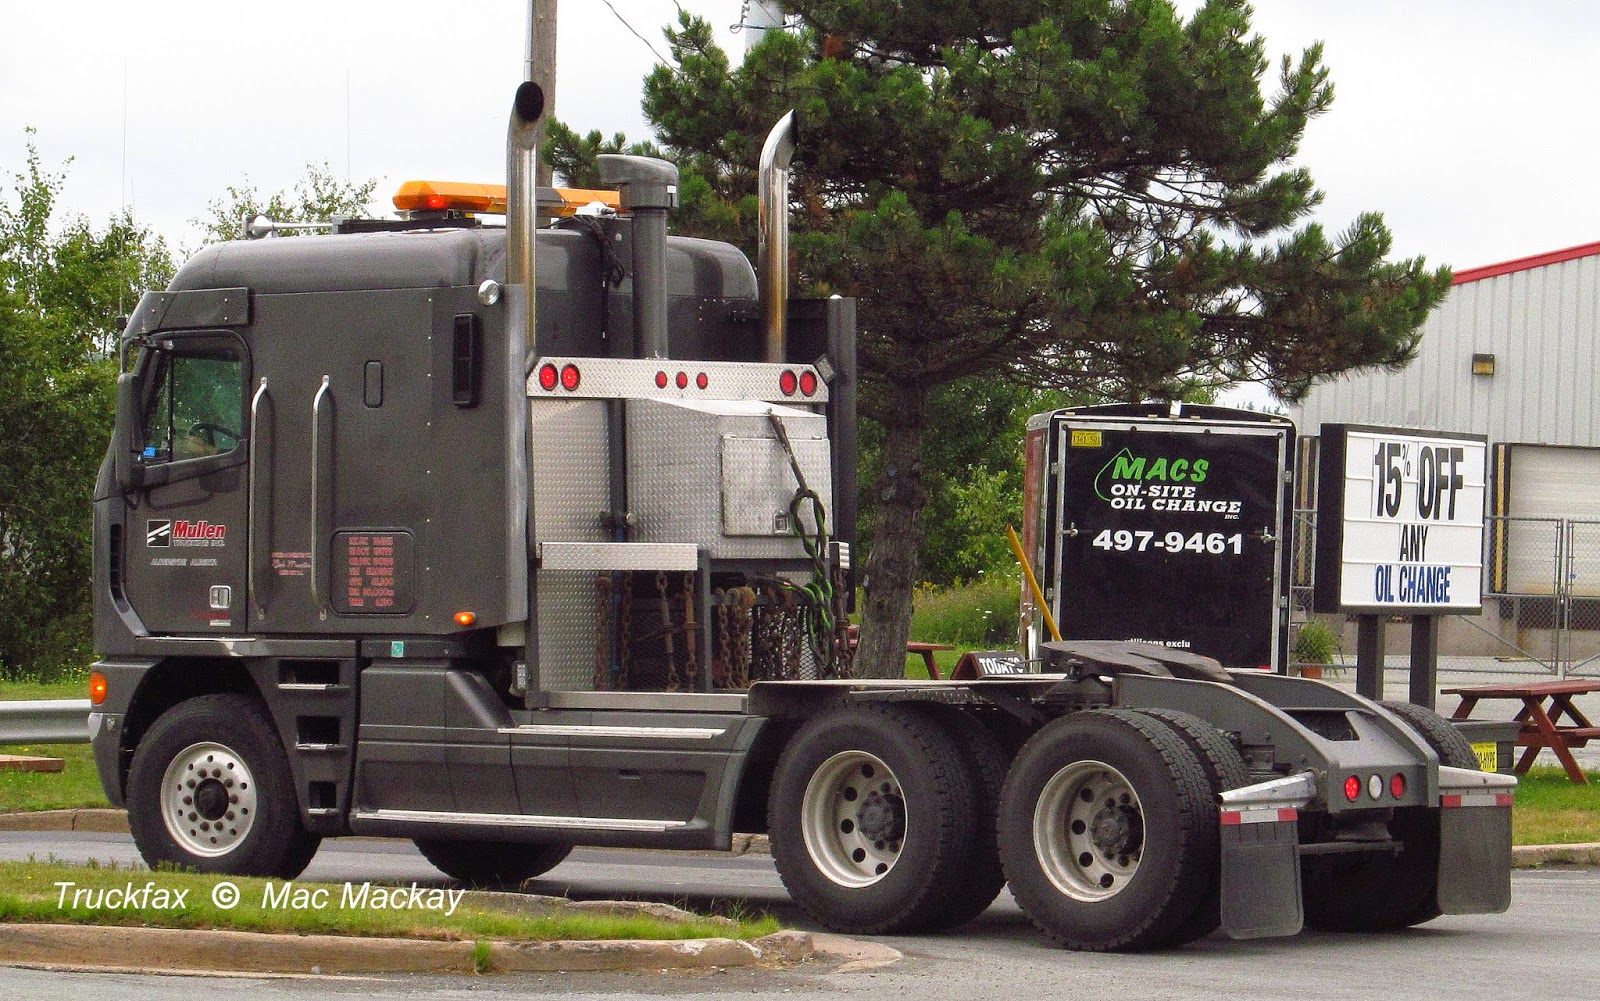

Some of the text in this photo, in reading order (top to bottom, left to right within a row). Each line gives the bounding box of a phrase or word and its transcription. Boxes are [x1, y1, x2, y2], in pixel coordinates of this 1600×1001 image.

[1111, 456, 1209, 482] MACS
[1110, 484, 1196, 498] ON-SITE
[1418, 445, 1464, 520] OFF
[1110, 497, 1242, 514] OIL CHANGE
[172, 520, 226, 539] Mullen
[1092, 529, 1242, 555] 497-9461
[1400, 524, 1429, 562] ANY
[1375, 564, 1451, 603] OIL CHANGE
